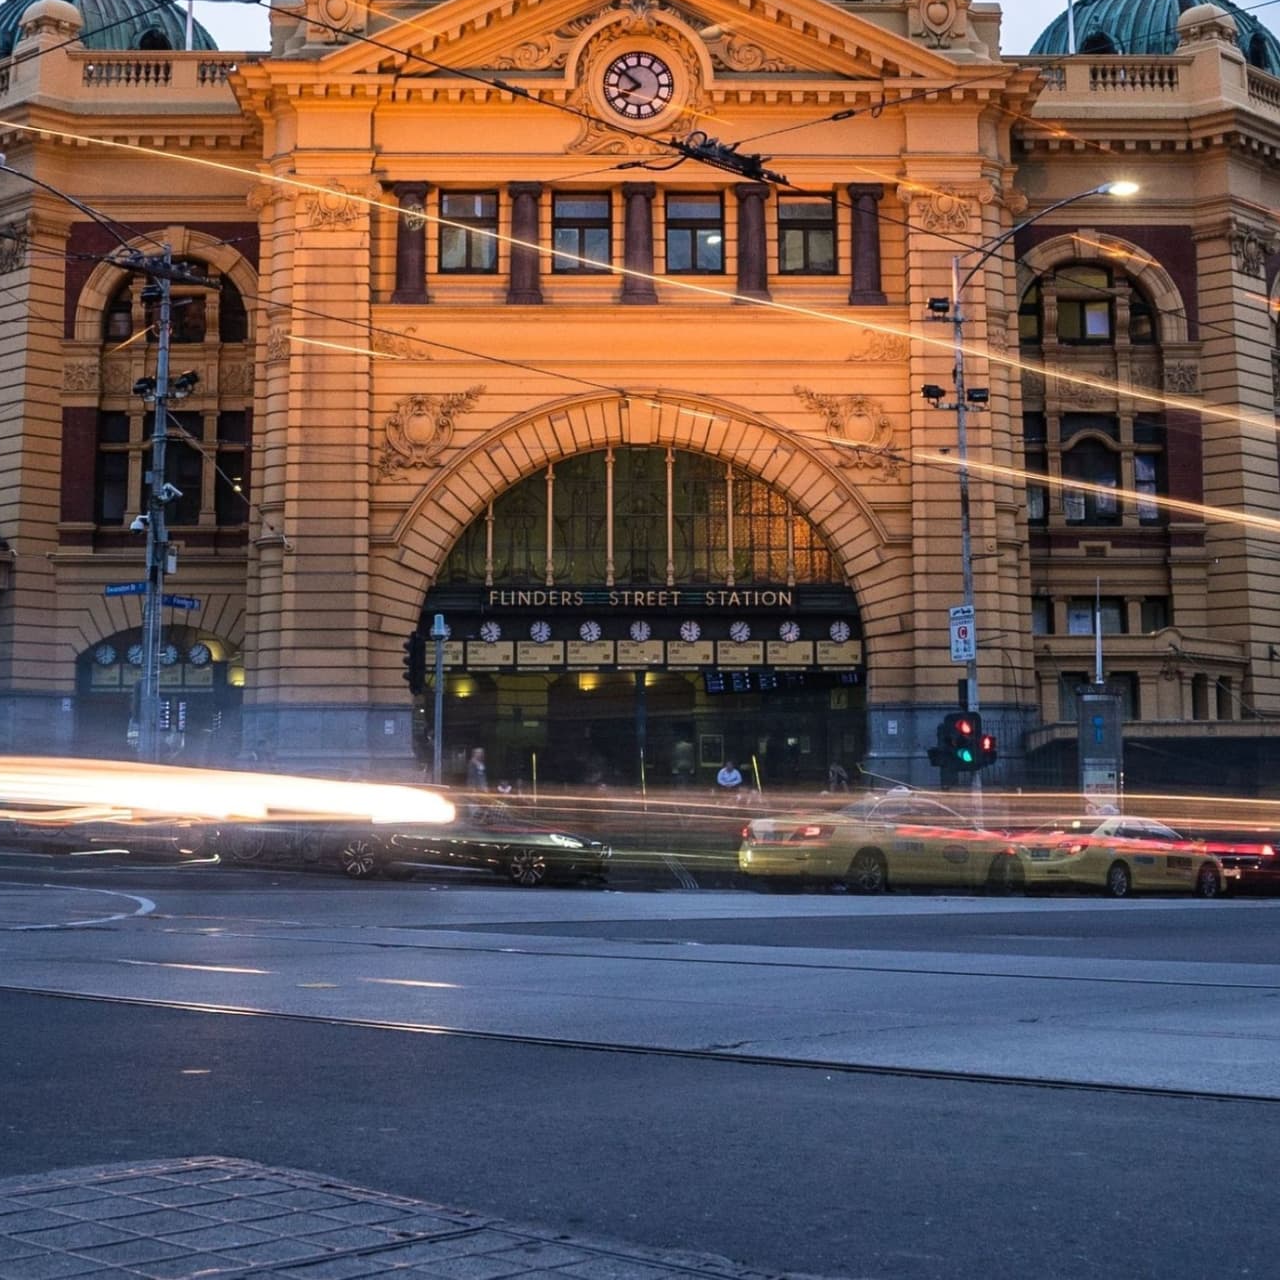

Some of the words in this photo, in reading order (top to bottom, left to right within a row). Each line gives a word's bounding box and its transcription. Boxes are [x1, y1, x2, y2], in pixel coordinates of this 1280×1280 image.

[489, 591, 584, 606] FLINDERS
[609, 591, 681, 606] STREET
[705, 591, 792, 606] STATION
